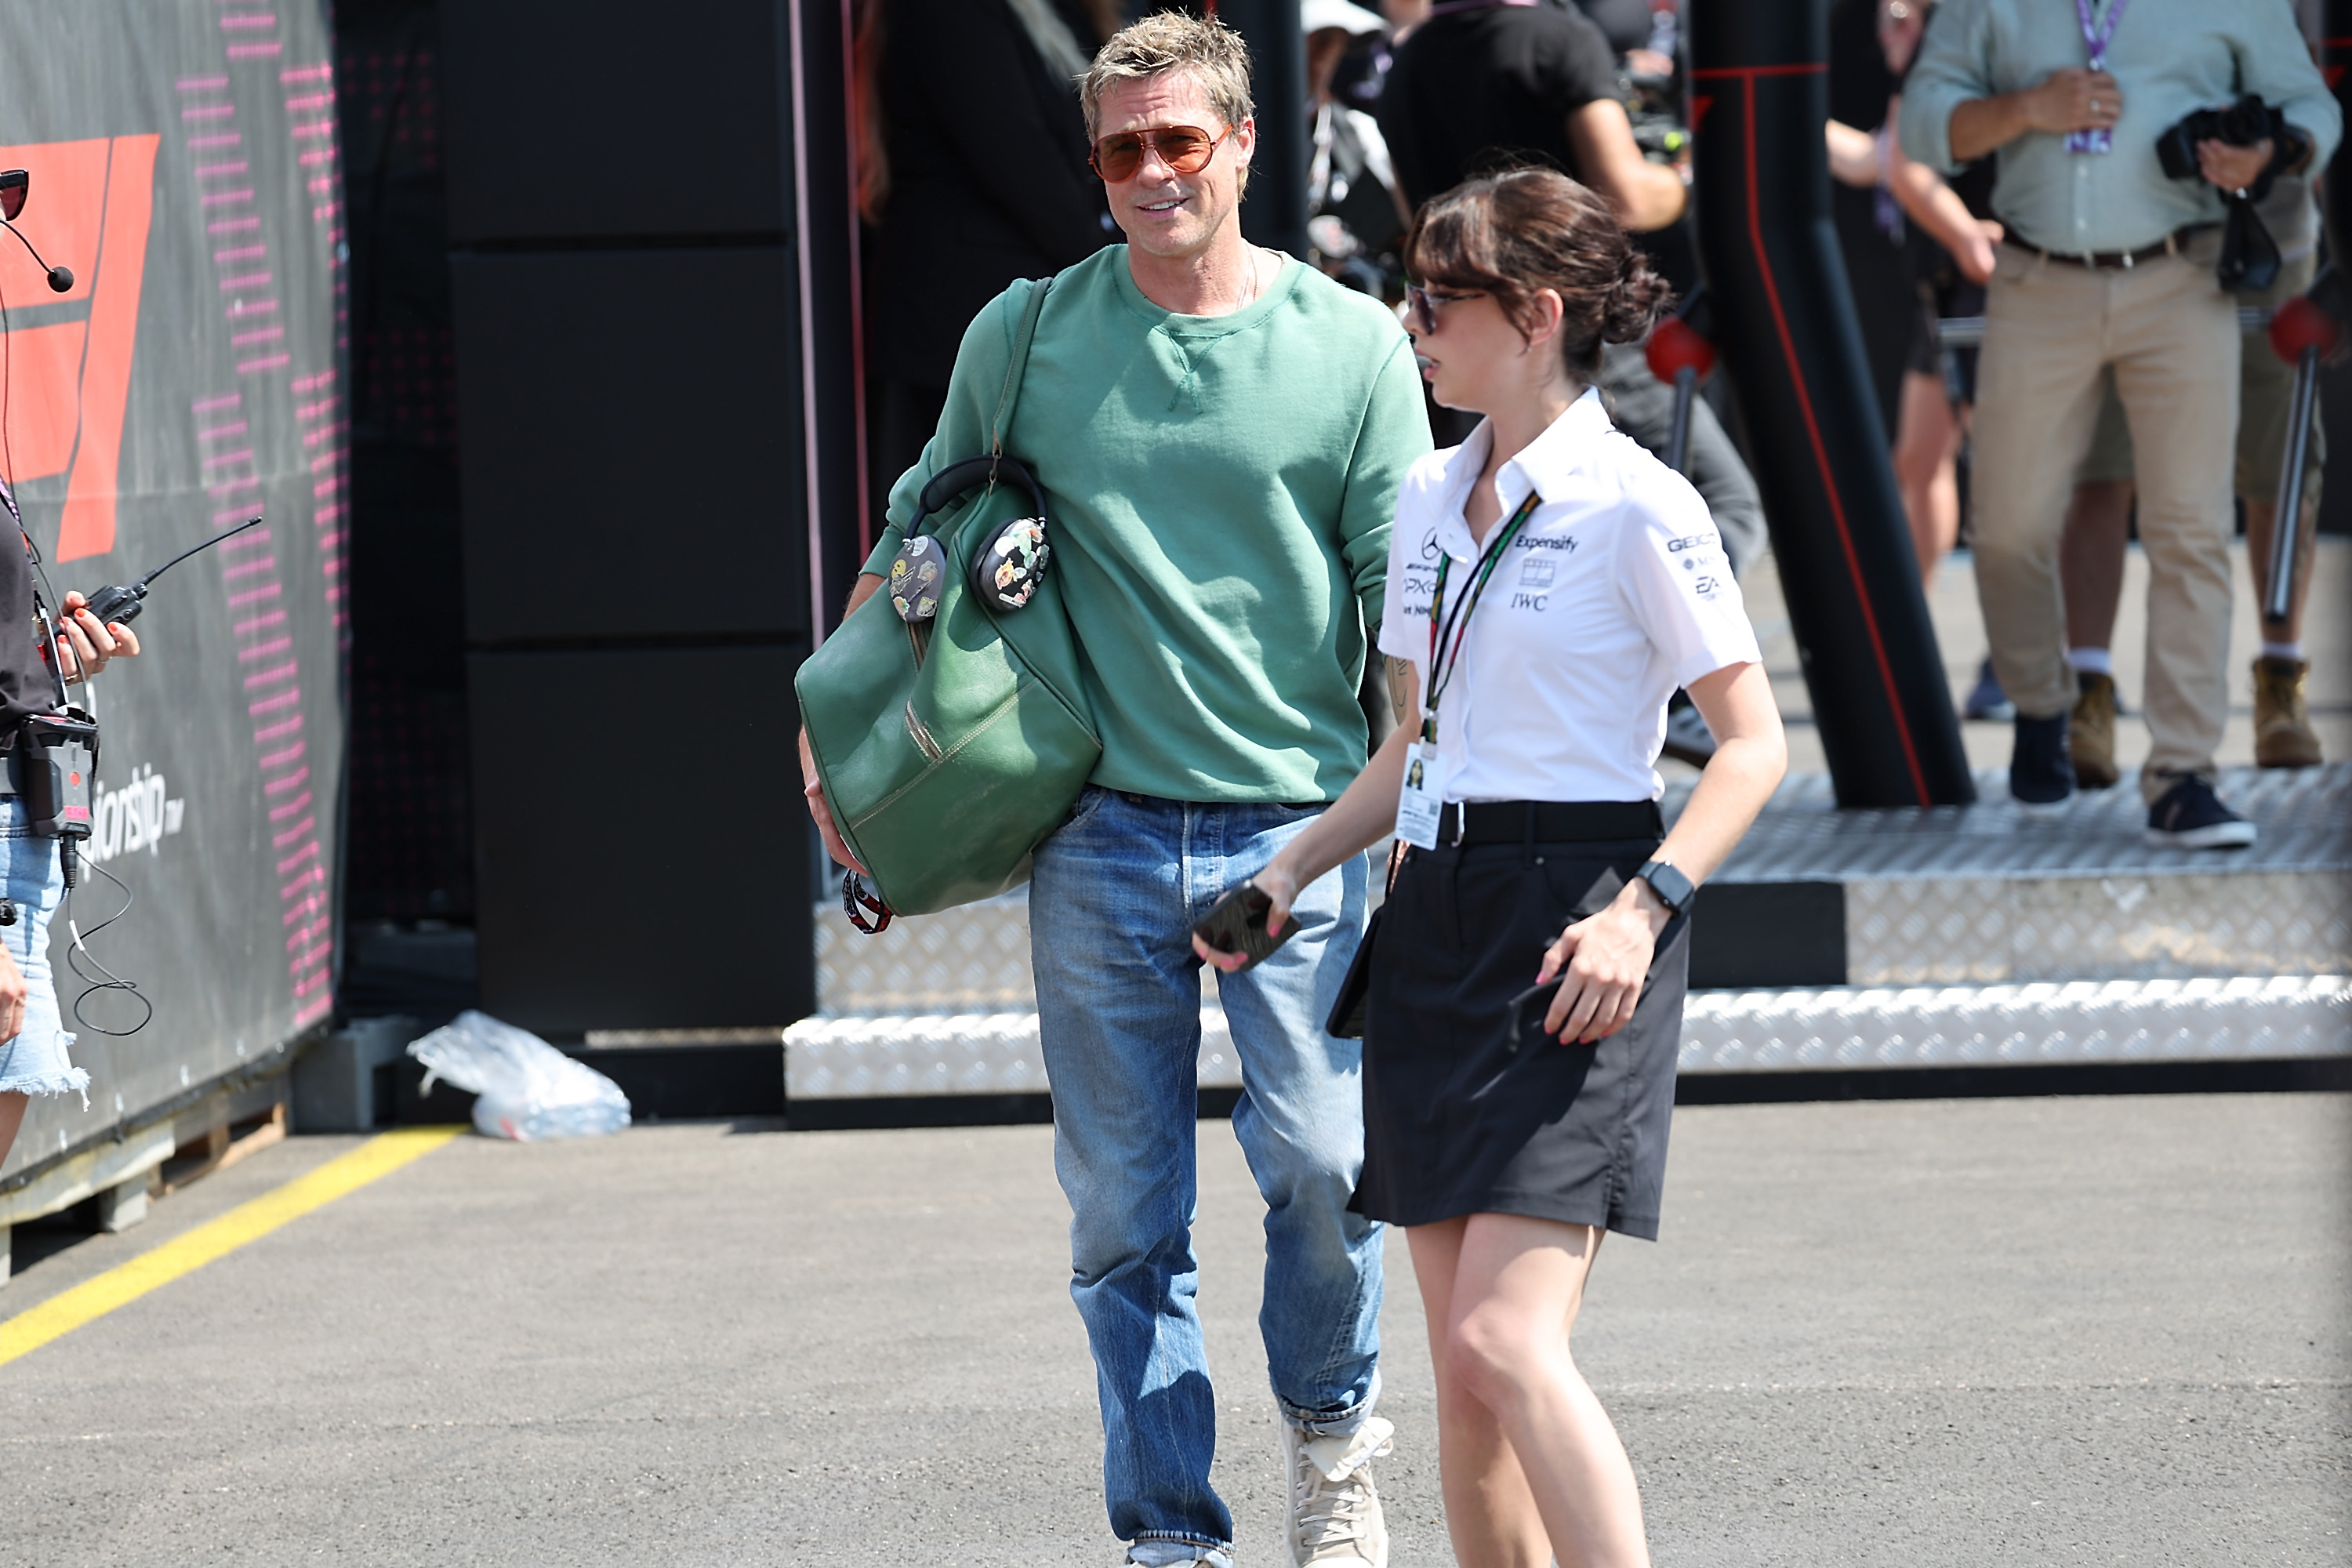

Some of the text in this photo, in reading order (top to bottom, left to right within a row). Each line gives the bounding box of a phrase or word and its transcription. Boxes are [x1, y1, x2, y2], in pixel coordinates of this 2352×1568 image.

[1515, 535, 1579, 554] Expensify
[1696, 576, 1721, 594] EA
[1511, 593, 1548, 612] IWC
